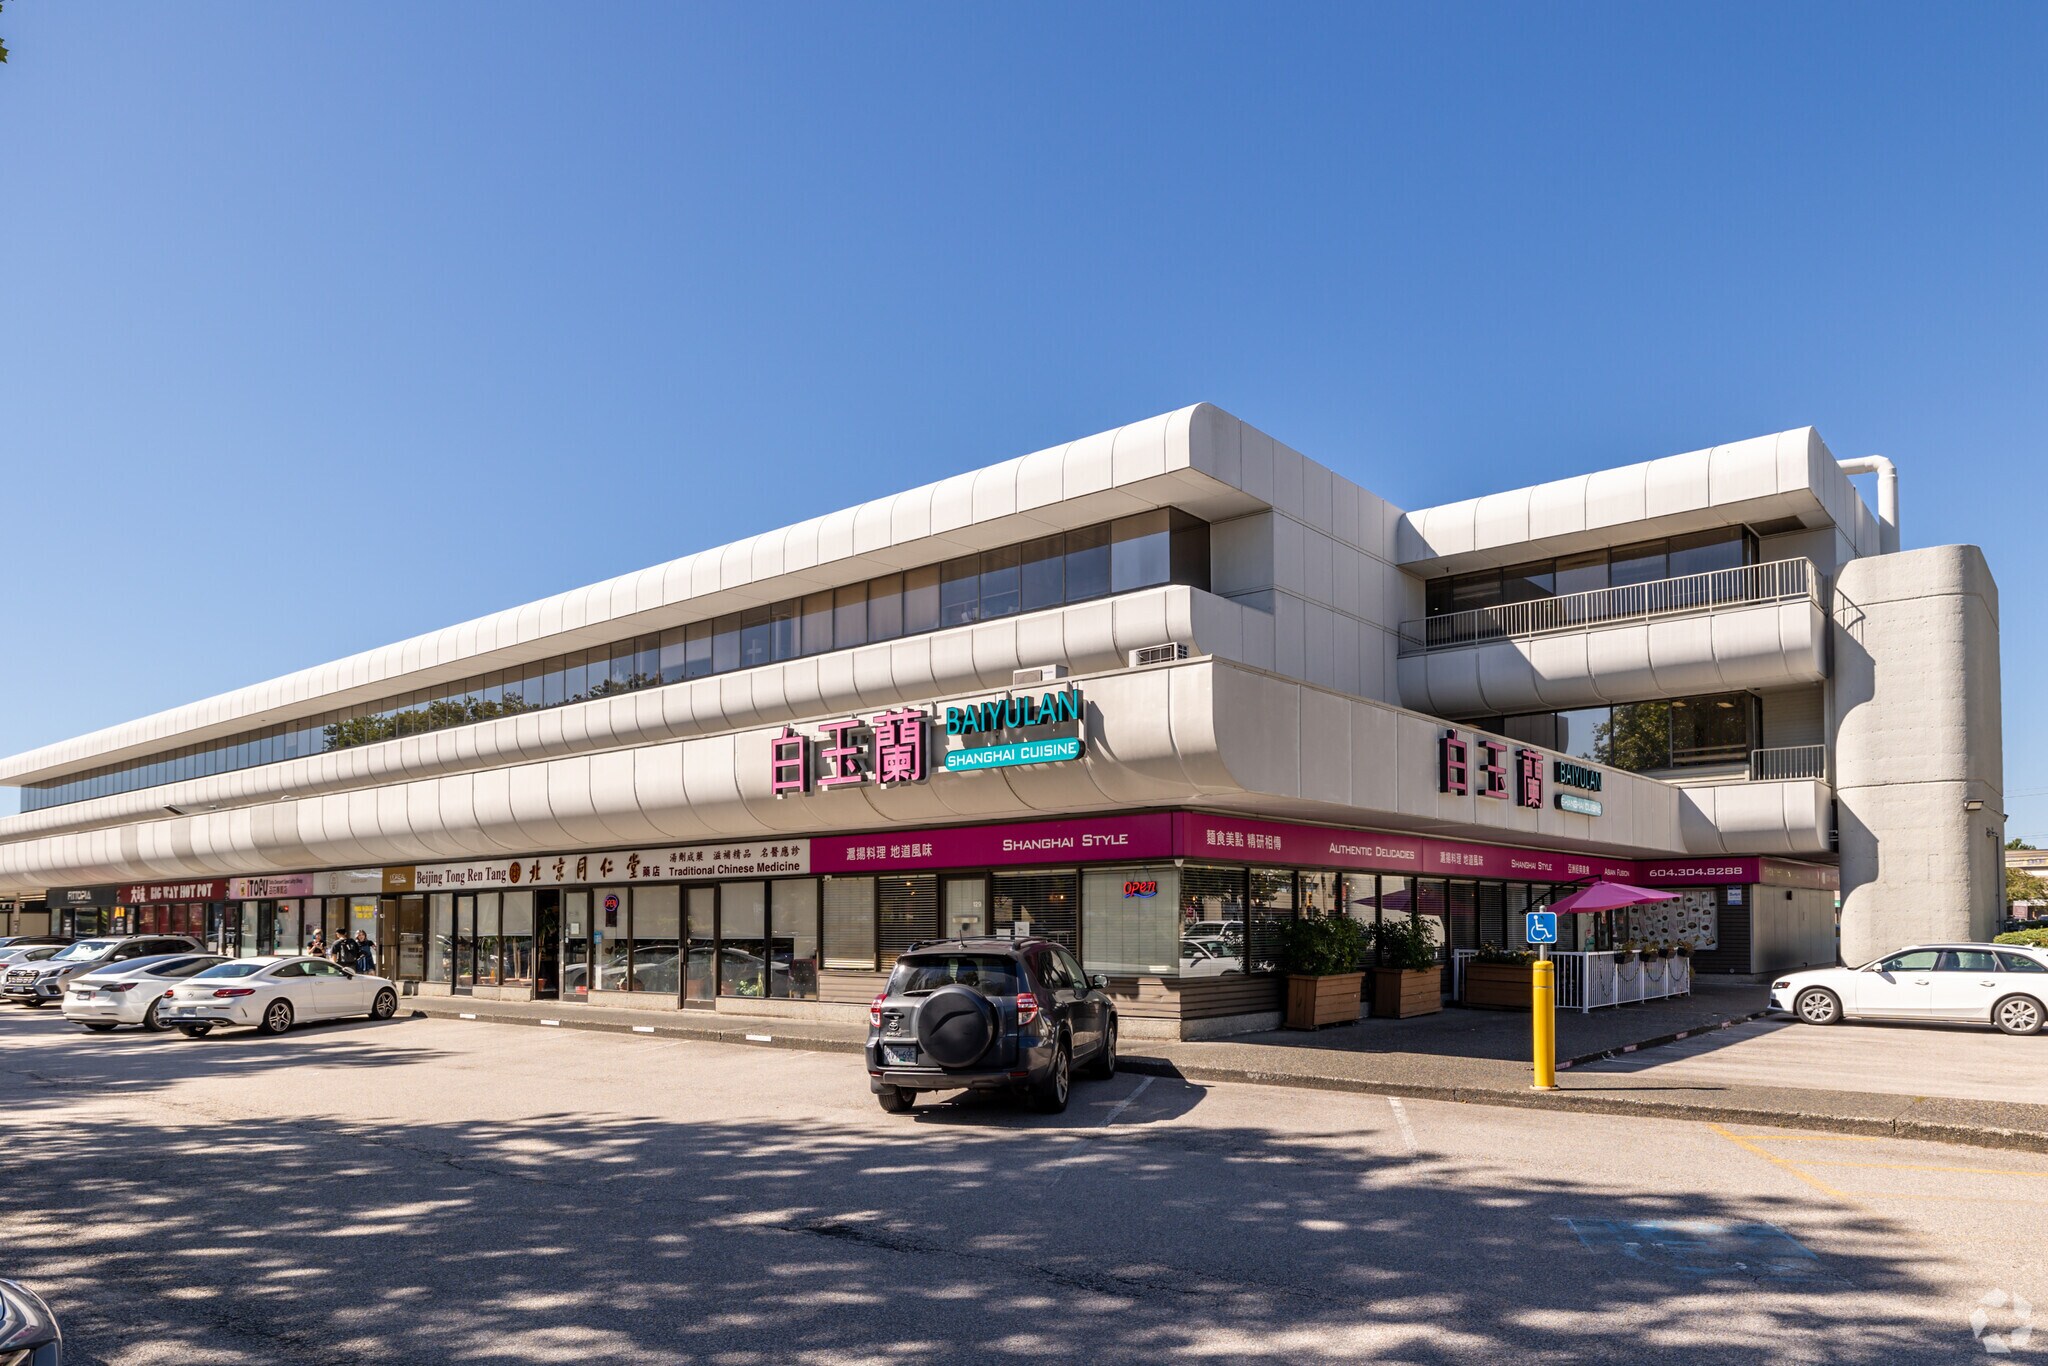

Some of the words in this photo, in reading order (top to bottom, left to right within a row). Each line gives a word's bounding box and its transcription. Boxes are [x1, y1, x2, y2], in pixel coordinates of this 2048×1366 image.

[946, 689, 1078, 735] BAIYULAN
[771, 706, 921, 795] 白玉蘭
[948, 749, 1015, 767] SHANGHAI
[1020, 742, 1077, 759] CUISINE
[1446, 729, 1543, 809] 白玉蘭
[1560, 761, 1602, 791] BAIYULAN
[1003, 837, 1073, 851] SHANGHAI
[1082, 834, 1129, 847] STYLE
[1329, 843, 1372, 856] AUTHENTIC
[1376, 846, 1415, 860] DELICACIES
[417, 871, 442, 887] Beijing
[446, 869, 465, 885] Tong
[467, 868, 483, 881] Ren
[485, 867, 506, 883] Tang
[529, 852, 641, 883] 北京同仁堂
[669, 865, 715, 876] Traditional
[717, 863, 754, 875] Chinese
[757, 861, 800, 872] Medicine
[1649, 866, 1743, 877] 604.304.8288
[150, 887, 162, 899] BIG
[163, 886, 179, 898] WAY
[180, 885, 196, 898] HOT
[197, 883, 213, 897] POT
